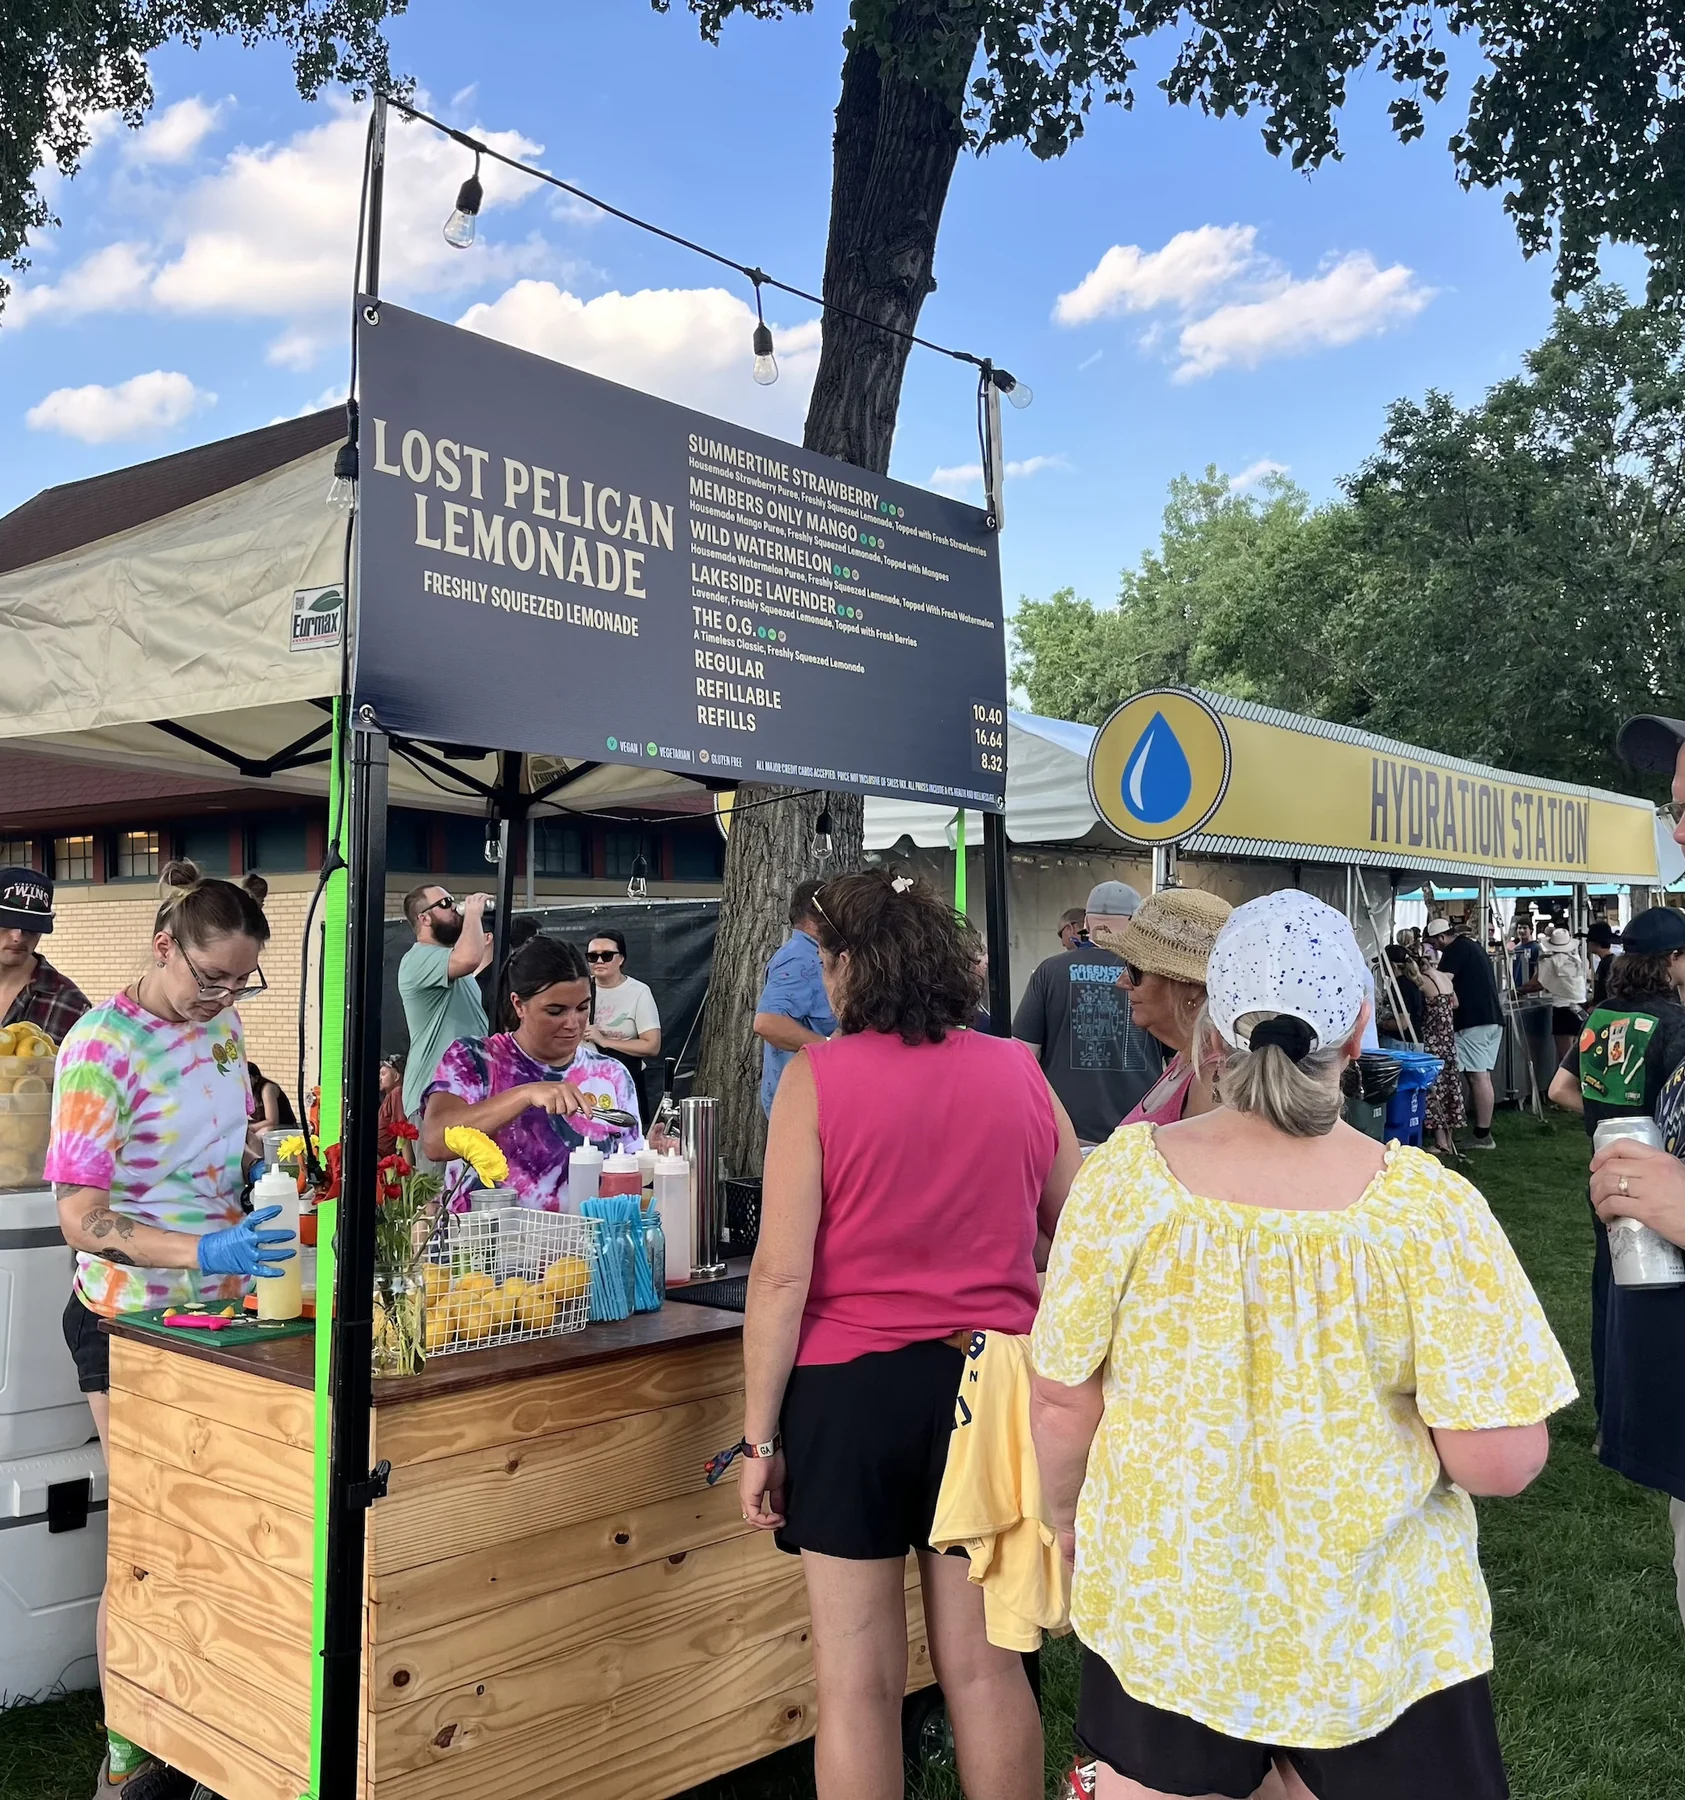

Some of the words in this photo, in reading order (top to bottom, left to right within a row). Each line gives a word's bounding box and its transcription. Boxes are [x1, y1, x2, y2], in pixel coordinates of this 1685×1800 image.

[373, 417, 489, 500] LOST
[503, 456, 675, 551] PELICAN
[688, 433, 788, 482] SUMMERTIME
[792, 467, 878, 510] STRAWBERRY
[688, 455, 734, 479] Housemade
[734, 470, 776, 495] Strawberry
[777, 483, 800, 501] Puree,
[801, 491, 826, 510] Freshly
[826, 499, 859, 518] Squeezed
[859, 509, 894, 530] Lemonade,
[894, 520, 917, 536] Topped
[917, 529, 931, 540] with
[932, 532, 949, 545] Fresh
[948, 537, 986, 557] Strawberries
[689, 475, 763, 514] MEMBERS
[766, 500, 803, 526] ONLY
[806, 511, 857, 542] MANGO
[414, 492, 646, 599] LEMONADE
[689, 498, 735, 521] Housemade
[736, 512, 762, 530] Mango
[763, 520, 786, 538] Puree,
[787, 527, 813, 545] Freshly
[813, 535, 846, 553] Squeezed
[847, 544, 883, 565] Lemonade,
[882, 554, 906, 569] Topped
[906, 562, 921, 573] with
[921, 565, 949, 581] Mangoes
[689, 518, 730, 546] WILD
[733, 530, 831, 574] WATERMELON
[424, 570, 488, 604] FRESHLY
[491, 586, 564, 621] SQUEEZED
[566, 603, 639, 637] LEMONADE
[690, 542, 736, 563] Housemade
[737, 554, 783, 576] Watermelon
[784, 566, 807, 583] Puree,
[807, 572, 833, 590] Freshly
[833, 579, 866, 597] Squeezed
[866, 588, 901, 607] Lemonade,
[901, 597, 925, 611] Topped
[925, 603, 940, 615] With
[940, 607, 958, 620] Fresh
[957, 611, 994, 628] Watermelon
[691, 562, 762, 597] LAKESIDE
[765, 580, 836, 614] LAVENDER
[293, 612, 339, 639] Eurmax
[691, 585, 730, 606] Lavender,
[731, 594, 758, 613] Freshly
[759, 601, 795, 619] Squeezed
[796, 609, 834, 630] Lemonade,
[834, 619, 859, 633] Topped
[860, 625, 875, 637] with
[875, 628, 894, 641] Fresh
[894, 632, 917, 647] Berries
[692, 605, 721, 629] THE
[725, 613, 756, 636] O.G.
[693, 629, 699, 639] A
[700, 630, 735, 647] Timeless
[736, 638, 766, 655] Classic,
[766, 644, 793, 661] Freshly
[794, 649, 829, 666] Squeezed
[829, 657, 864, 673] Lemonade
[694, 648, 764, 679] REGULAR
[696, 676, 781, 709] REFILLABLE
[972, 704, 1002, 725] 10.40
[697, 704, 756, 731] REFILLS
[975, 728, 1003, 749] 16.64
[620, 741, 638, 754] VEGAN
[659, 746, 691, 761] VEGETARIAN
[711, 753, 731, 766] GLUTEN
[730, 756, 743, 768] FREE
[981, 752, 1002, 773] 8.32
[1370, 757, 1506, 858] HYDRATION
[1511, 791, 1589, 865] STATION
[4, 885, 49, 908] TWINS
